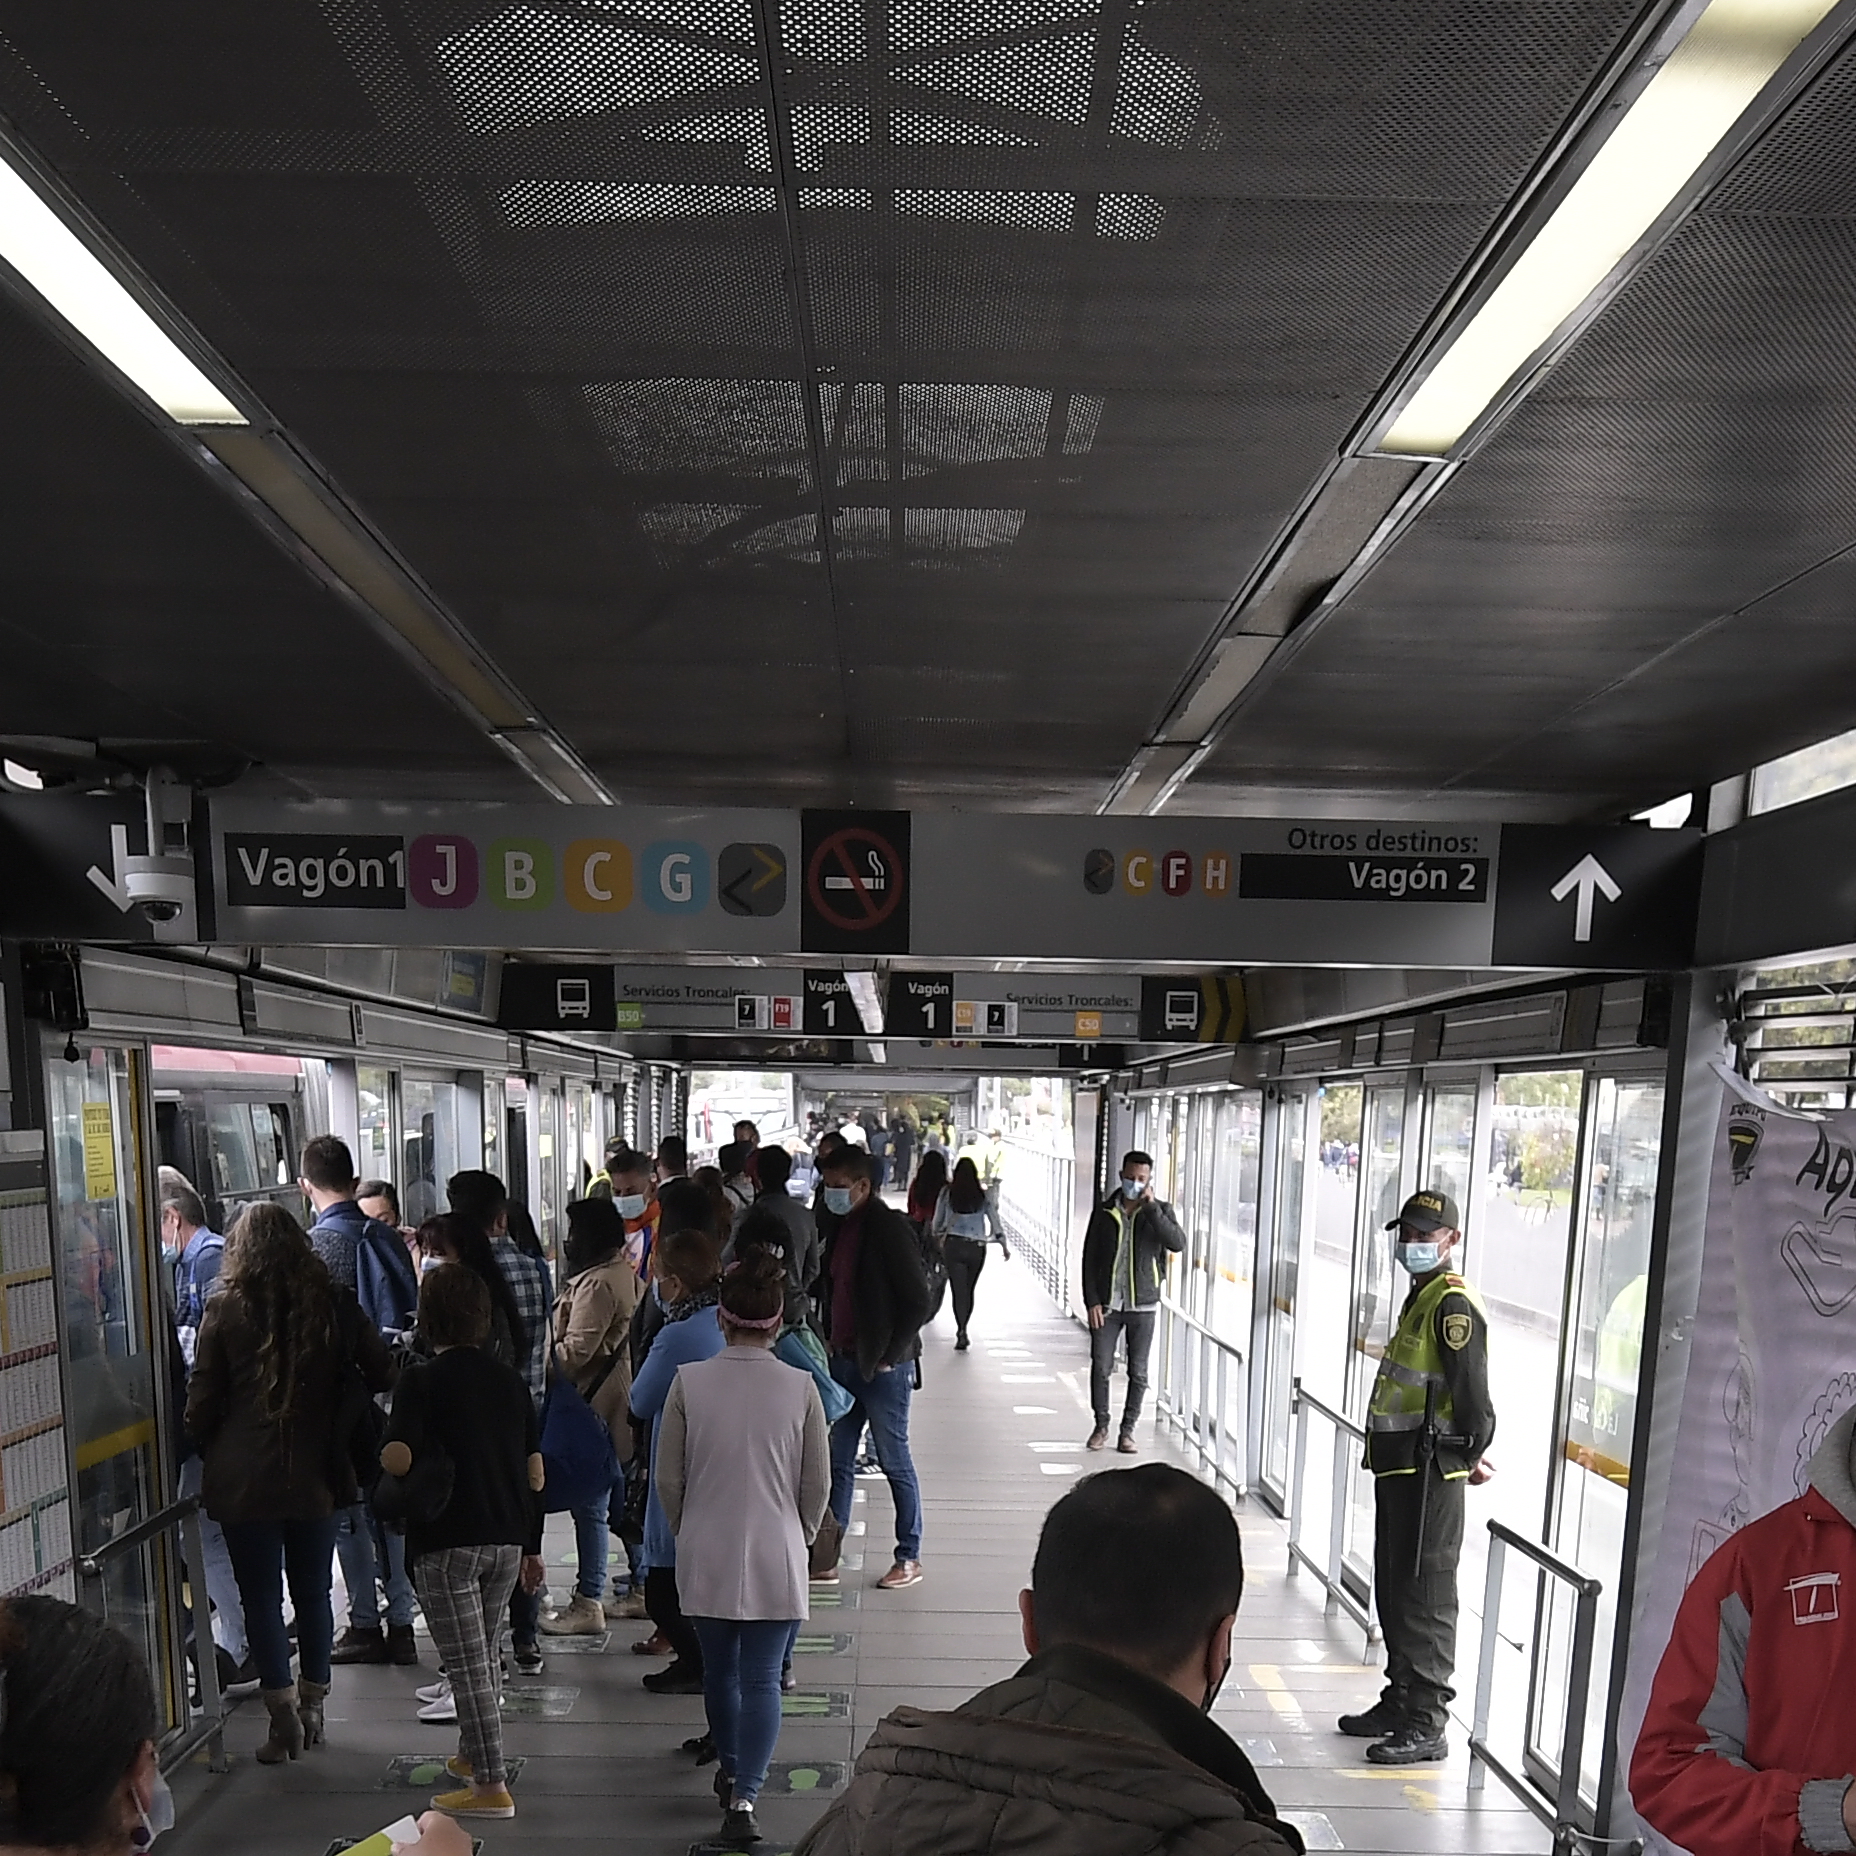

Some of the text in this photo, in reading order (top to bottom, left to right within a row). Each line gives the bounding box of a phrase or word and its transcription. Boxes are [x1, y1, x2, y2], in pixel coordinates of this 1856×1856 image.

[1286, 828, 1480, 854] Otros destinos:
[430, 845, 694, 902] J B C G
[1127, 856, 1227, 891] C F H
[1347, 861, 1477, 897] Vagón 2
[622, 984, 681, 999] Servicios
[907, 980, 950, 998] Vagón
[1067, 993, 1134, 1008] Troncales:
[820, 1000, 836, 1028] 1
[919, 1002, 937, 1030] 1
